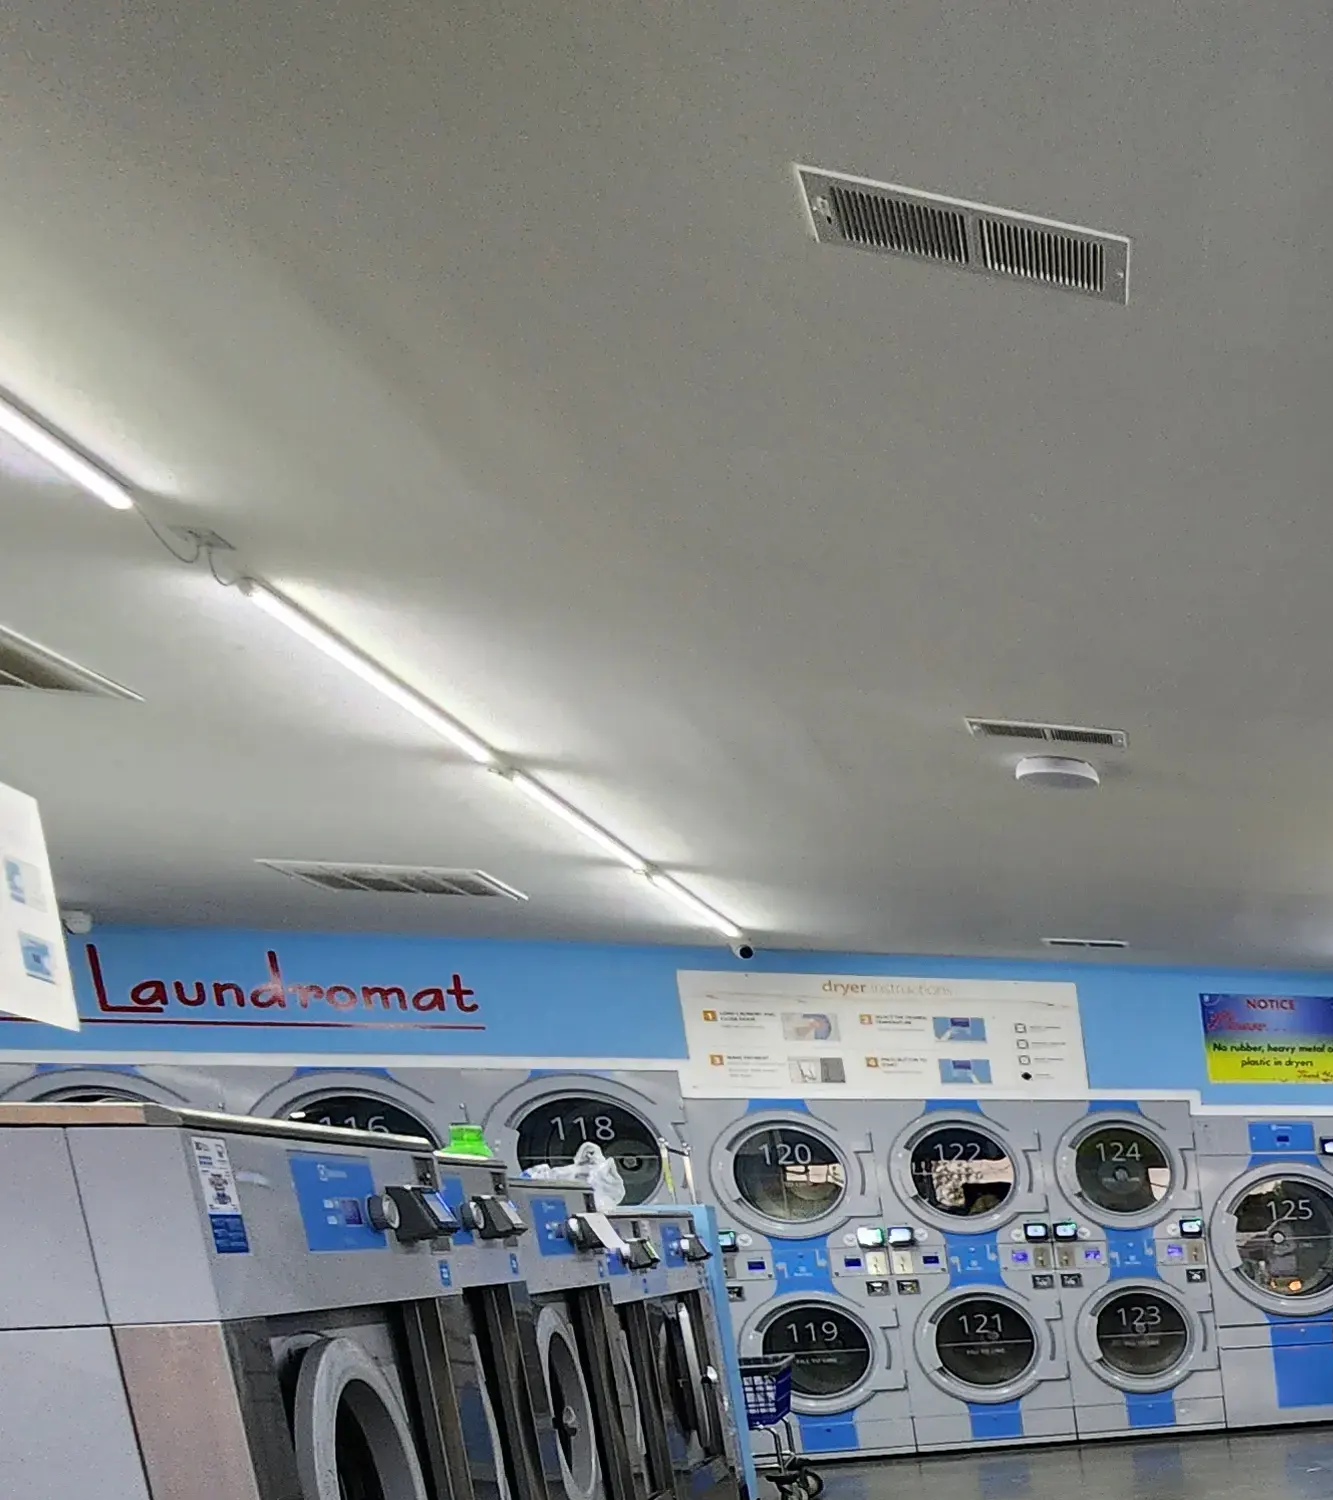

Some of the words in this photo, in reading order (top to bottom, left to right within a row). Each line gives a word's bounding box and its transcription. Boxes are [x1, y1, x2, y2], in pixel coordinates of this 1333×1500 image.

[86, 943, 479, 1013] Laundromat
[822, 979, 867, 996] dryer
[1246, 998, 1295, 1010] NOTICE
[1212, 1043, 1227, 1052] No
[1230, 1043, 1265, 1053] rubber,
[1267, 1044, 1296, 1054] heavy
[1299, 1044, 1325, 1052] metal
[1241, 1056, 1271, 1067] plastic
[1274, 1057, 1282, 1066] in
[1285, 1057, 1314, 1068] dryers
[550, 1115, 616, 1141] 118
[758, 1143, 812, 1166] 120
[933, 1142, 981, 1164] 122
[1095, 1142, 1141, 1163] 124
[1266, 1200, 1313, 1221] 125
[958, 1312, 1004, 1335] 121
[1116, 1306, 1162, 1327] 123
[786, 1321, 839, 1343] 119
